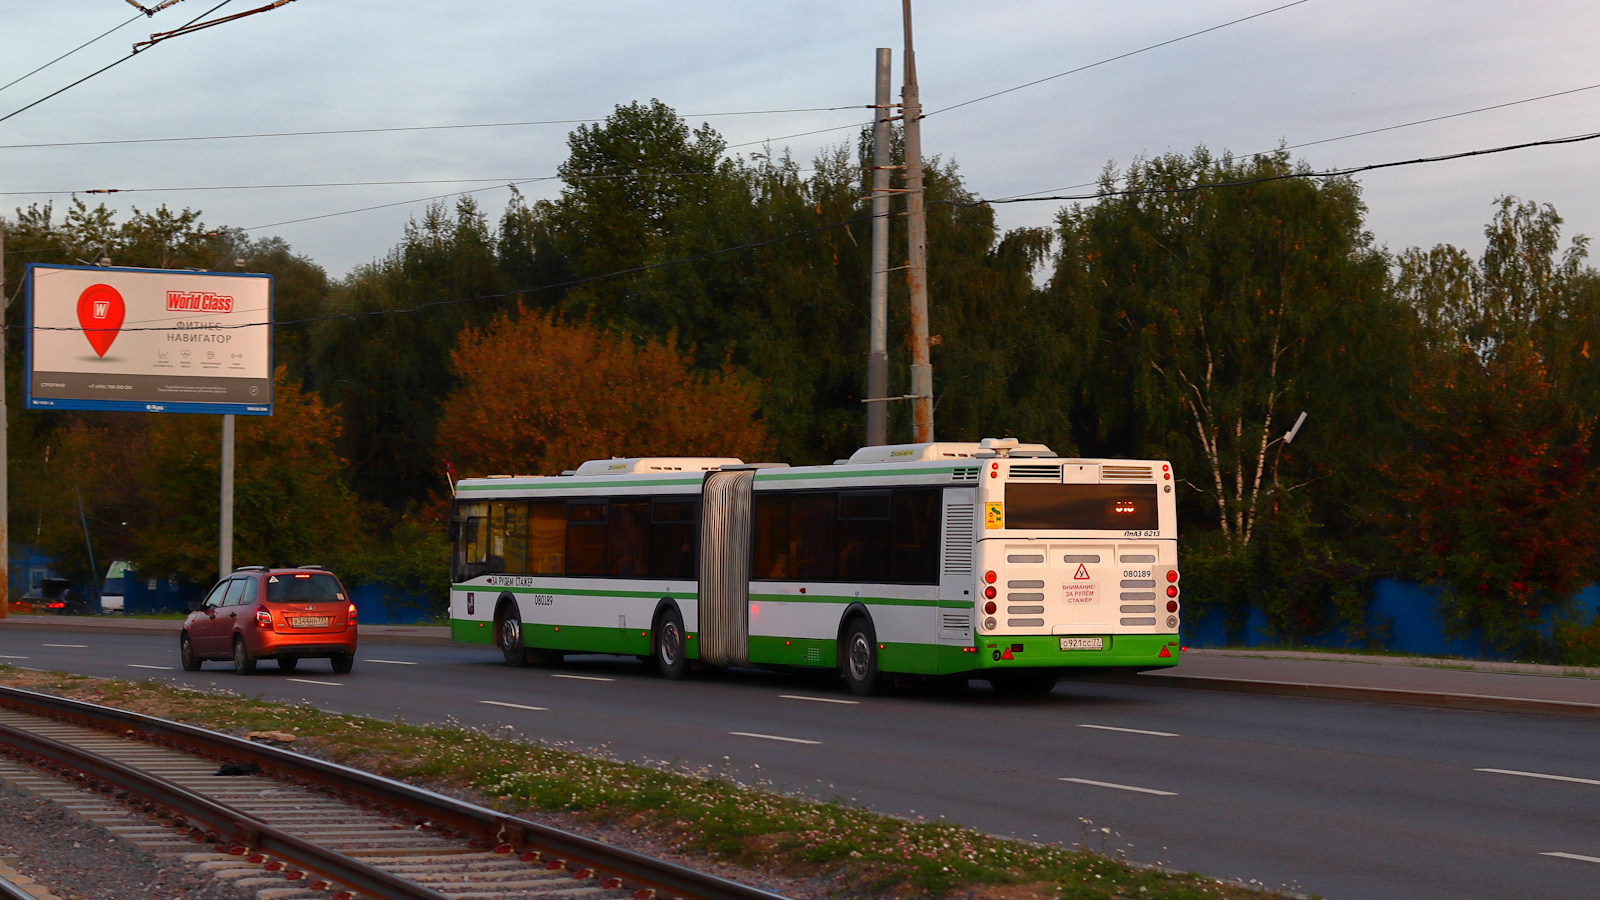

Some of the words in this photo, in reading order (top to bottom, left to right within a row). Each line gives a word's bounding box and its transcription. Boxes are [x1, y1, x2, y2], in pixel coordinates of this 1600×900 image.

[168, 293, 201, 310] World
[202, 294, 232, 311] Class
[176, 321, 223, 332] ФИТНЕС
[167, 333, 232, 344] НАВИГАТОР
[1123, 570, 1151, 578] 080189
[491, 576, 498, 585] ЗА
[535, 595, 553, 606] 080189
